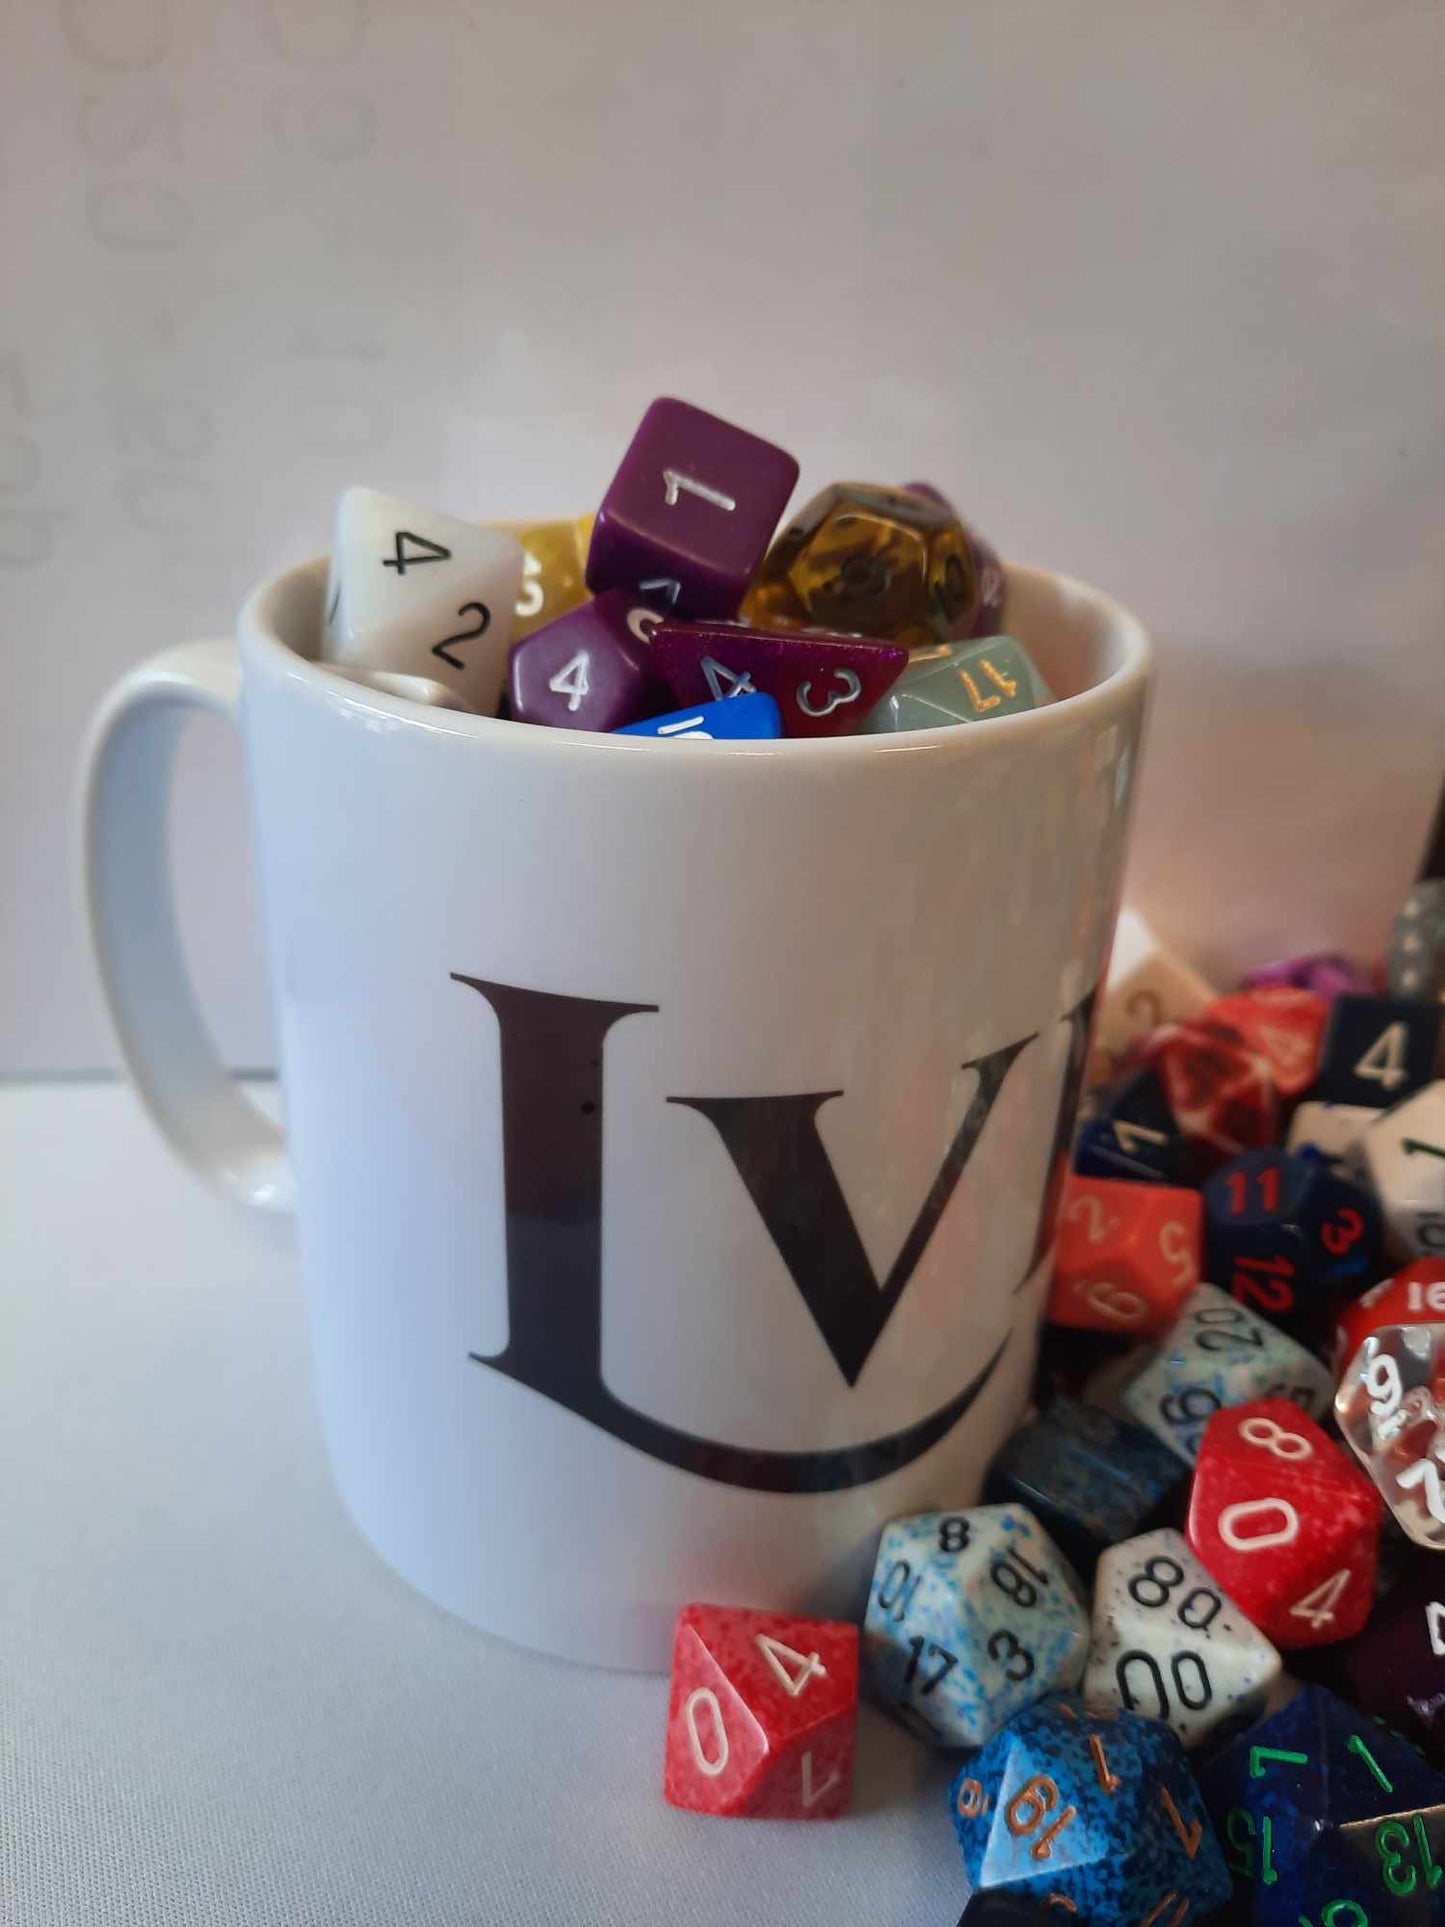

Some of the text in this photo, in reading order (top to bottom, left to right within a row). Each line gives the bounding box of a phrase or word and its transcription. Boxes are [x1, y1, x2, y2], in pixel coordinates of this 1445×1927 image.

[383, 530, 451, 575] 4
[431, 602, 491, 670] 2
[549, 649, 591, 712] 4
[797, 667, 861, 717] 3
[1354, 1021, 1410, 1091] 4
[1225, 1165, 1281, 1216] 11
[1321, 1208, 1365, 1256] 3
[1238, 1416, 1314, 1460] 8
[939, 1515, 971, 1552] 8
[1218, 1496, 1300, 1552] 0
[1127, 1555, 1222, 1630] 80
[1289, 1568, 1354, 1629] 4
[755, 1633, 827, 1697] 4
[987, 1630, 1035, 1682] 3
[685, 1686, 730, 1777] 0
